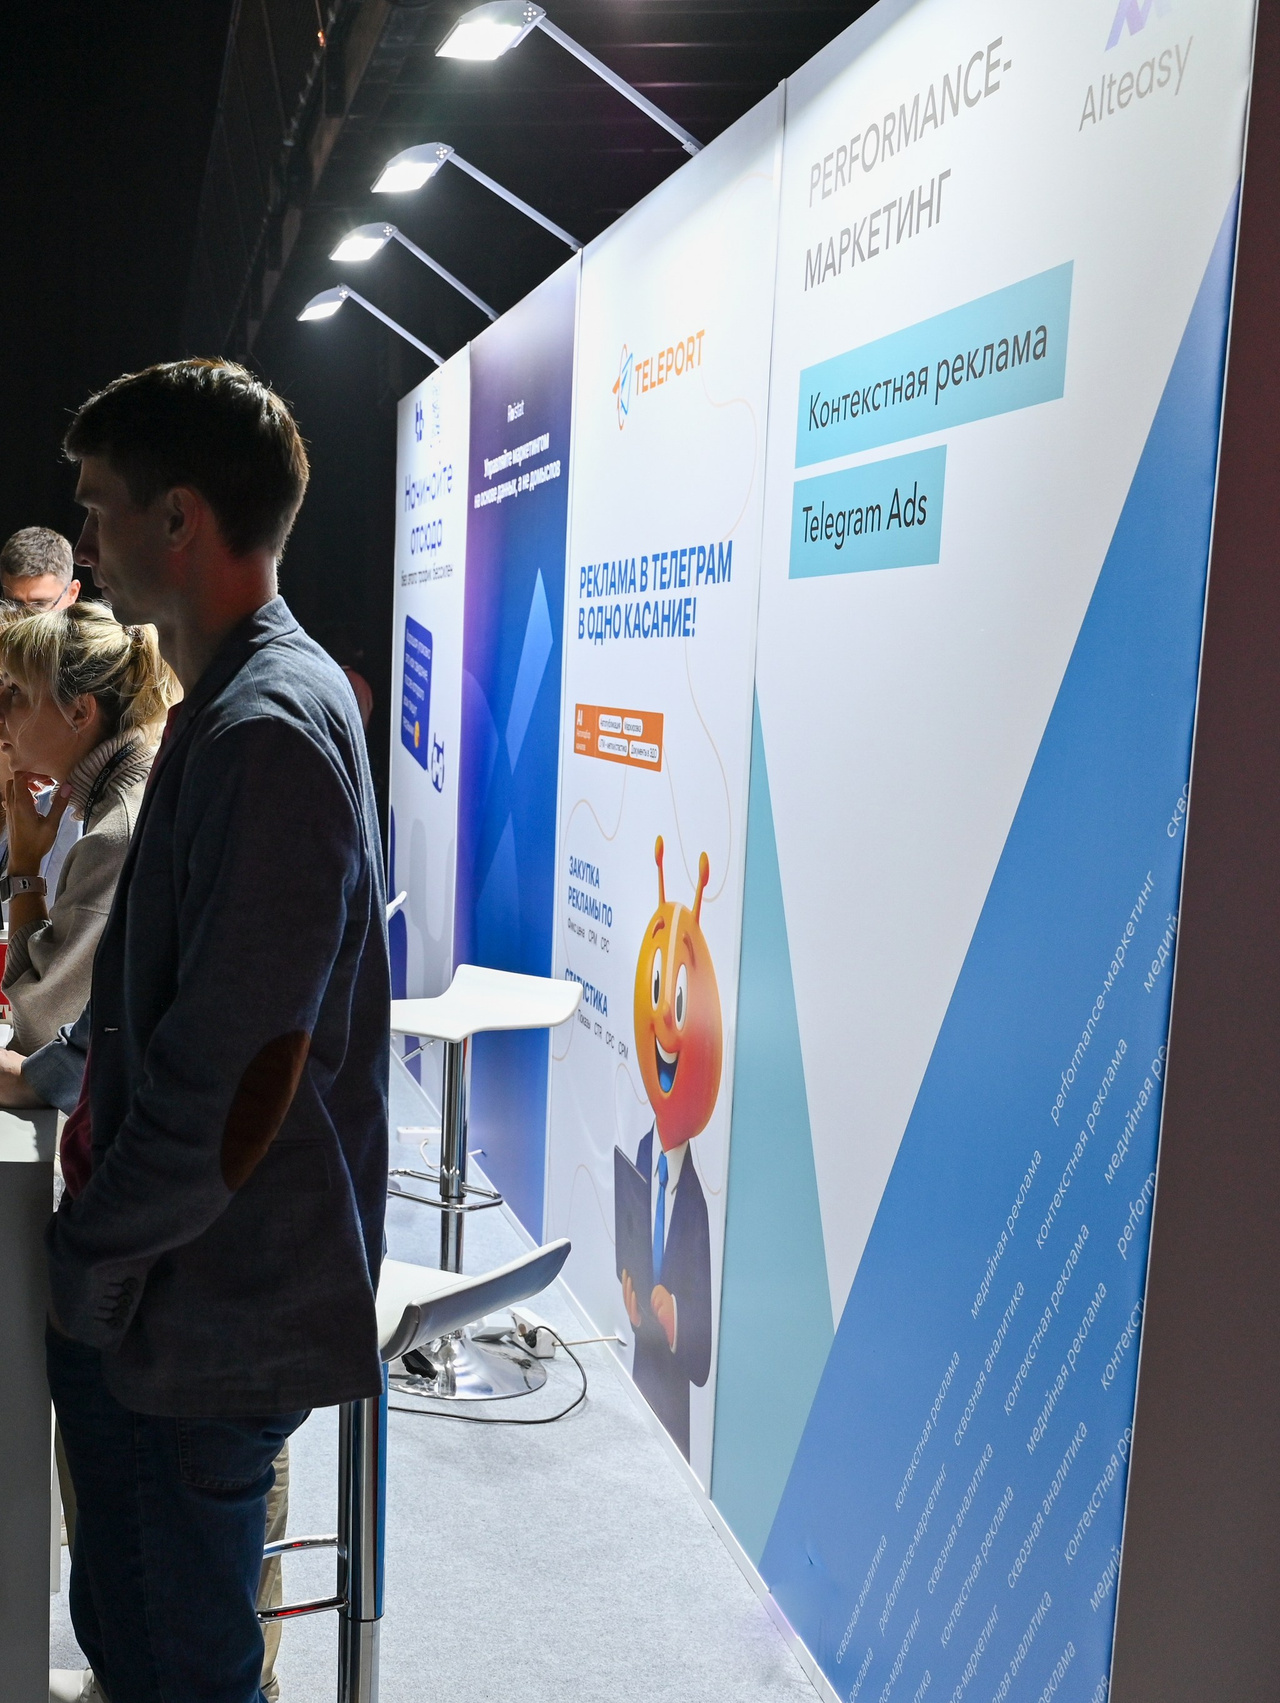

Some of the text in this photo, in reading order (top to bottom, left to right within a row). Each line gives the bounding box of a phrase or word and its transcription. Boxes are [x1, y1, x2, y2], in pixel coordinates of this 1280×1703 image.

[808, 35, 1012, 208] PERFORMANCE-
[1078, 35, 1194, 132] Alteasy
[803, 168, 952, 292] МАРКЕТИНГ
[634, 329, 705, 396] TELEPORT
[807, 324, 1048, 432] Контекстная реклама
[579, 540, 733, 599] РЕКЛАМА В ТЕЛЕГРАМ
[802, 481, 928, 550] Telegram Ads
[578, 597, 697, 646] В ОДНО КАСАНИЕ!
[568, 886, 613, 929] РЕКЛАМЫ ПО
[569, 856, 600, 889] ЗАКУПКА
[1050, 870, 1156, 1127] performance-маркетинг
[1036, 1038, 1129, 1250] контекстная реклама
[1104, 1077, 1154, 1185] медийная
[970, 1150, 1042, 1320] медийная реклама
[953, 1281, 1025, 1447] сквозная аналитика
[1004, 1224, 1090, 1417] контекстная реклама
[1026, 1282, 1108, 1456] медийная реклама
[1100, 1298, 1147, 1392] контекст
[894, 1351, 961, 1513] контекстная реклама
[878, 1463, 949, 1638] performance-маркетинг
[927, 1443, 994, 1595] сквозная аналитика
[940, 1486, 1015, 1649] контекстная реклама
[1006, 1421, 1088, 1590] сквозная аналитика
[1063, 1452, 1120, 1566] контекстная
[835, 1534, 888, 1665] сквозная аналитика
[1009, 1590, 1052, 1677] аналитика
